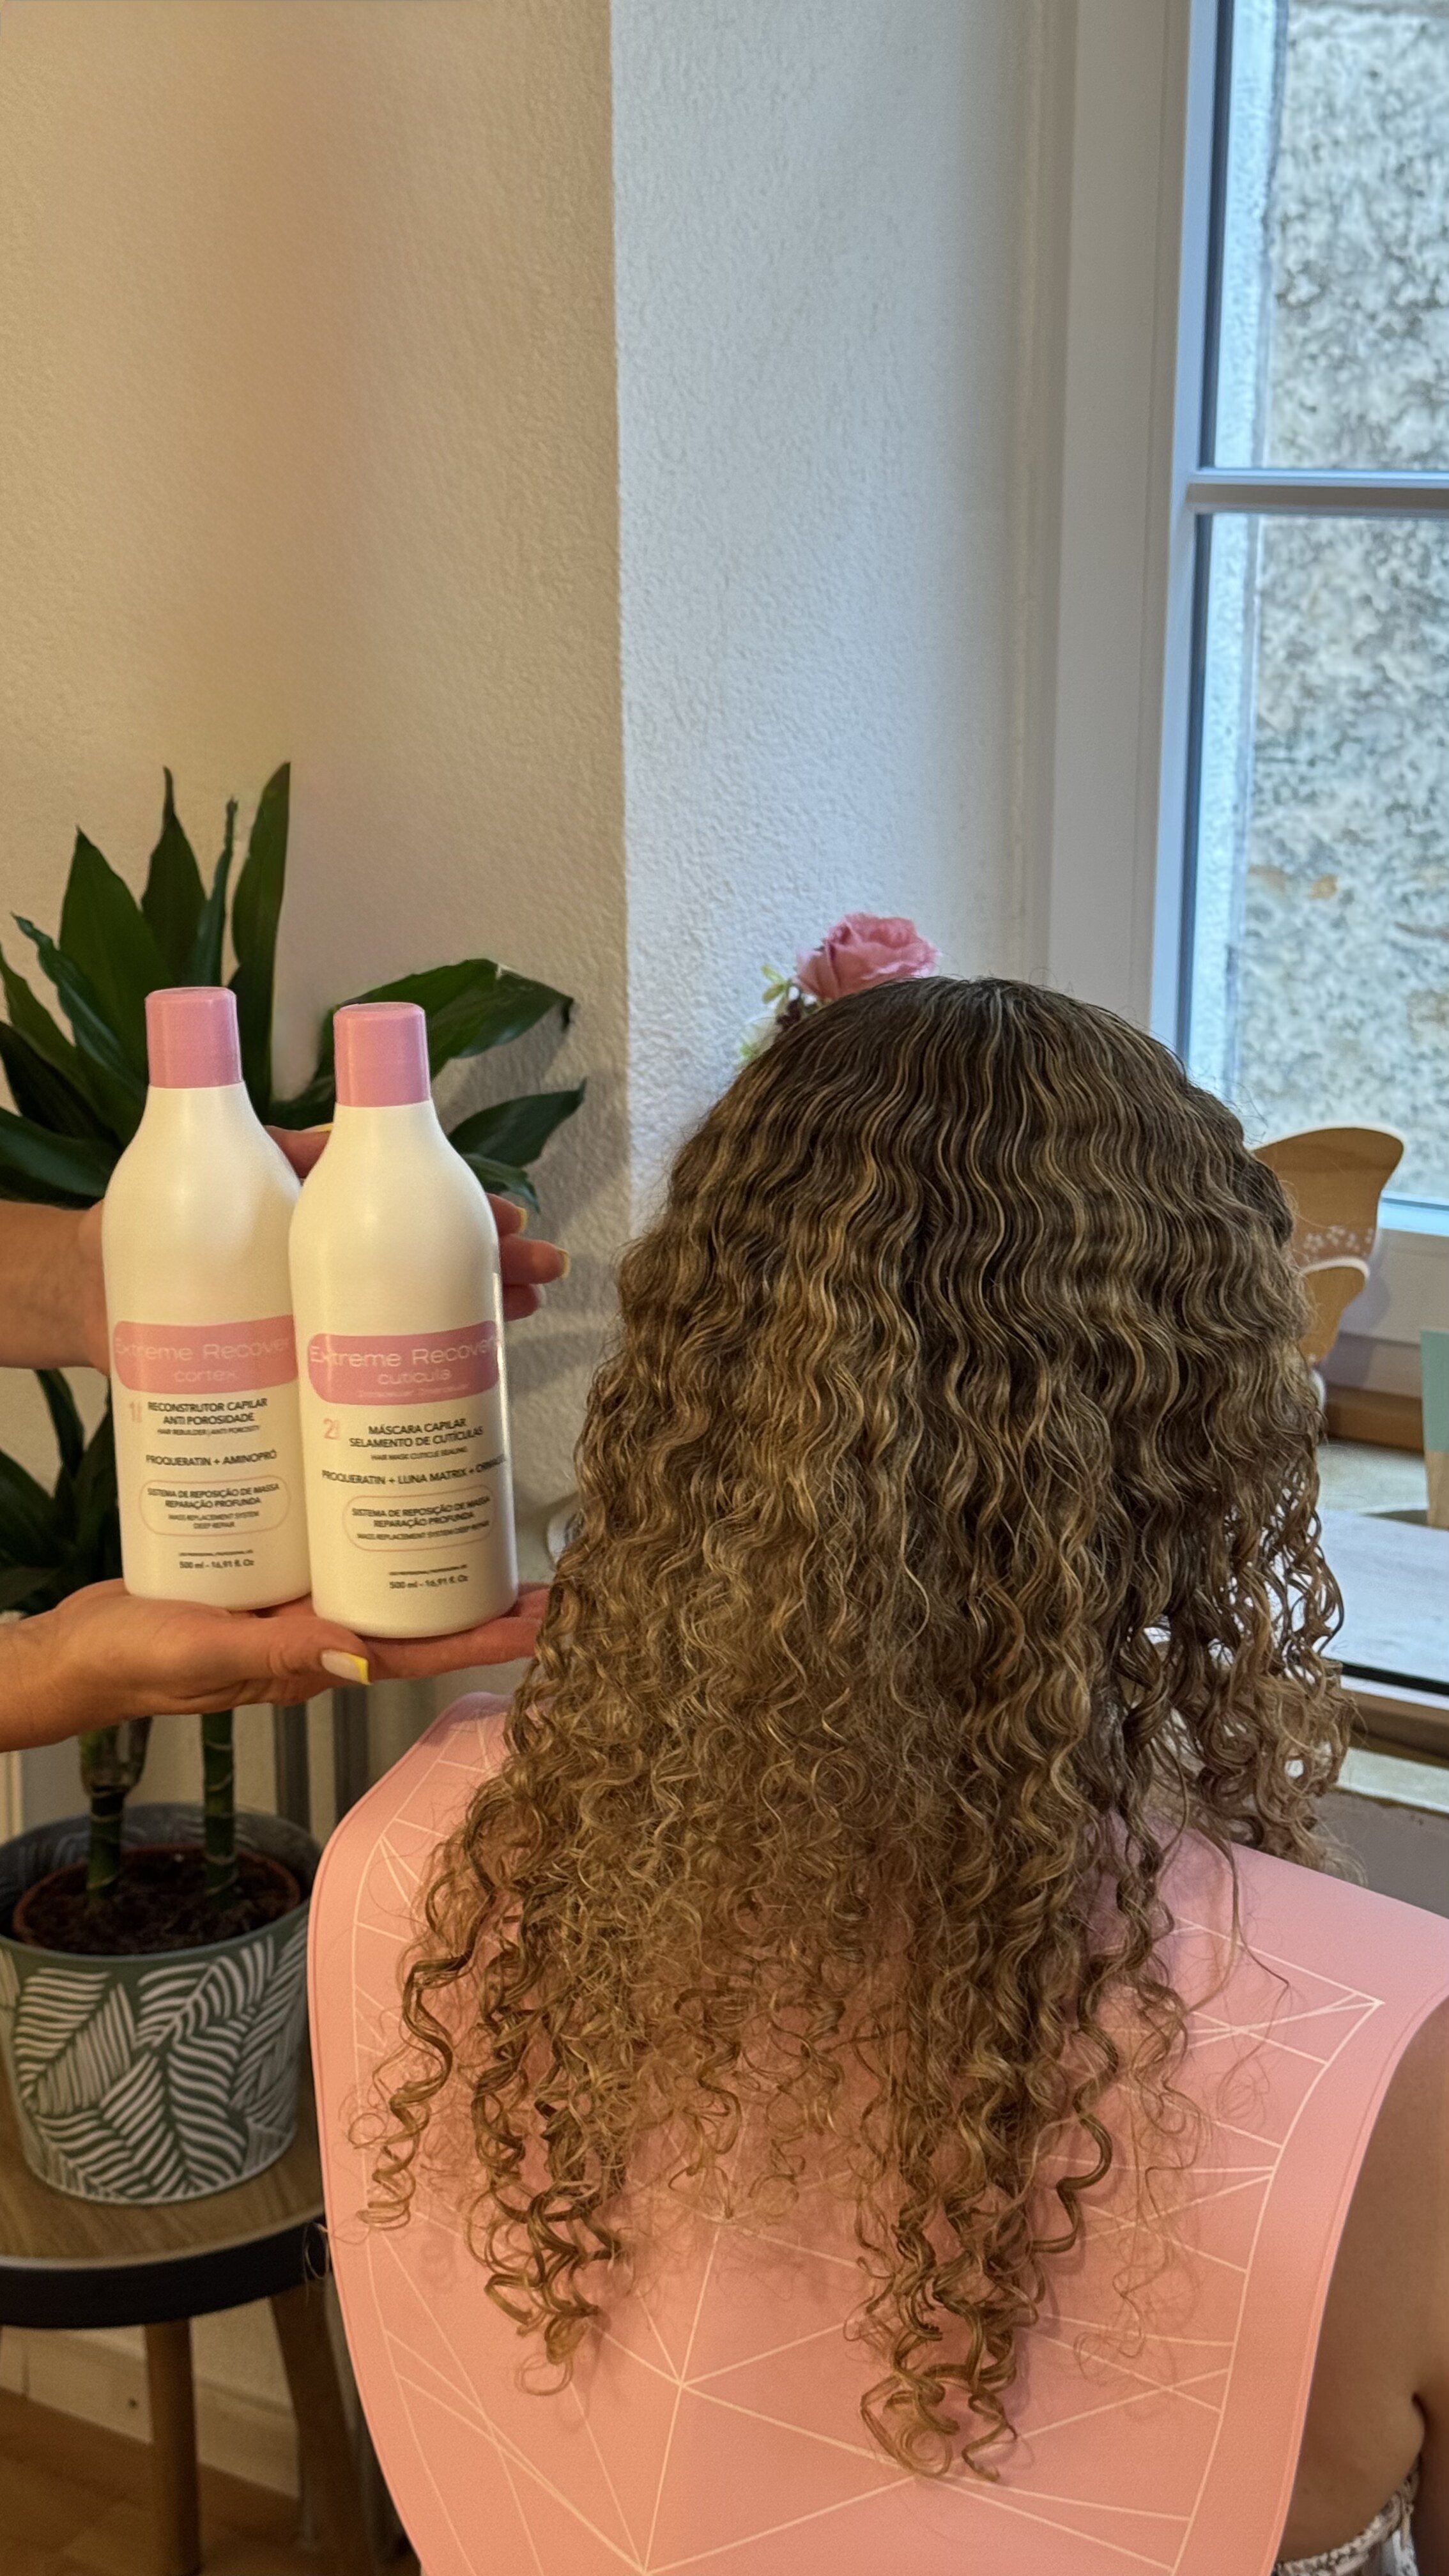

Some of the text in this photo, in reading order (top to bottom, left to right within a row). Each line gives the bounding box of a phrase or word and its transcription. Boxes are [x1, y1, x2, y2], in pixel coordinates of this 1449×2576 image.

[310, 1345, 402, 1367] Extreme
[174, 1369, 237, 1383] cortex
[148, 1398, 268, 1413] RECONSTRUTOR CAPILAR
[163, 1413, 255, 1425] ANTI POROSIDADE
[368, 1418, 467, 1435] MÁSCARA CAPILAR
[349, 1426, 484, 1448] SELAMENTO DE CUTÍCULAS
[146, 1455, 211, 1466] PROQUERATIN
[322, 1469, 385, 1484] PROQUERATIN
[397, 1473, 427, 1484] LUNA
[429, 1469, 467, 1482] MATRIX
[148, 1487, 177, 1498] SISTEMA
[190, 1488, 238, 1499] REPOSIÇÃO
[240, 1487, 252, 1496] DE
[253, 1483, 280, 1493] MASSA
[165, 1497, 261, 1510] REPARAÇÃO PROFUNDA
[352, 1496, 491, 1517] SISTEMA DE REPOSIÇÃO DE MASSA
[374, 1512, 475, 1529] REPARAÇÃO PROFUNDA
